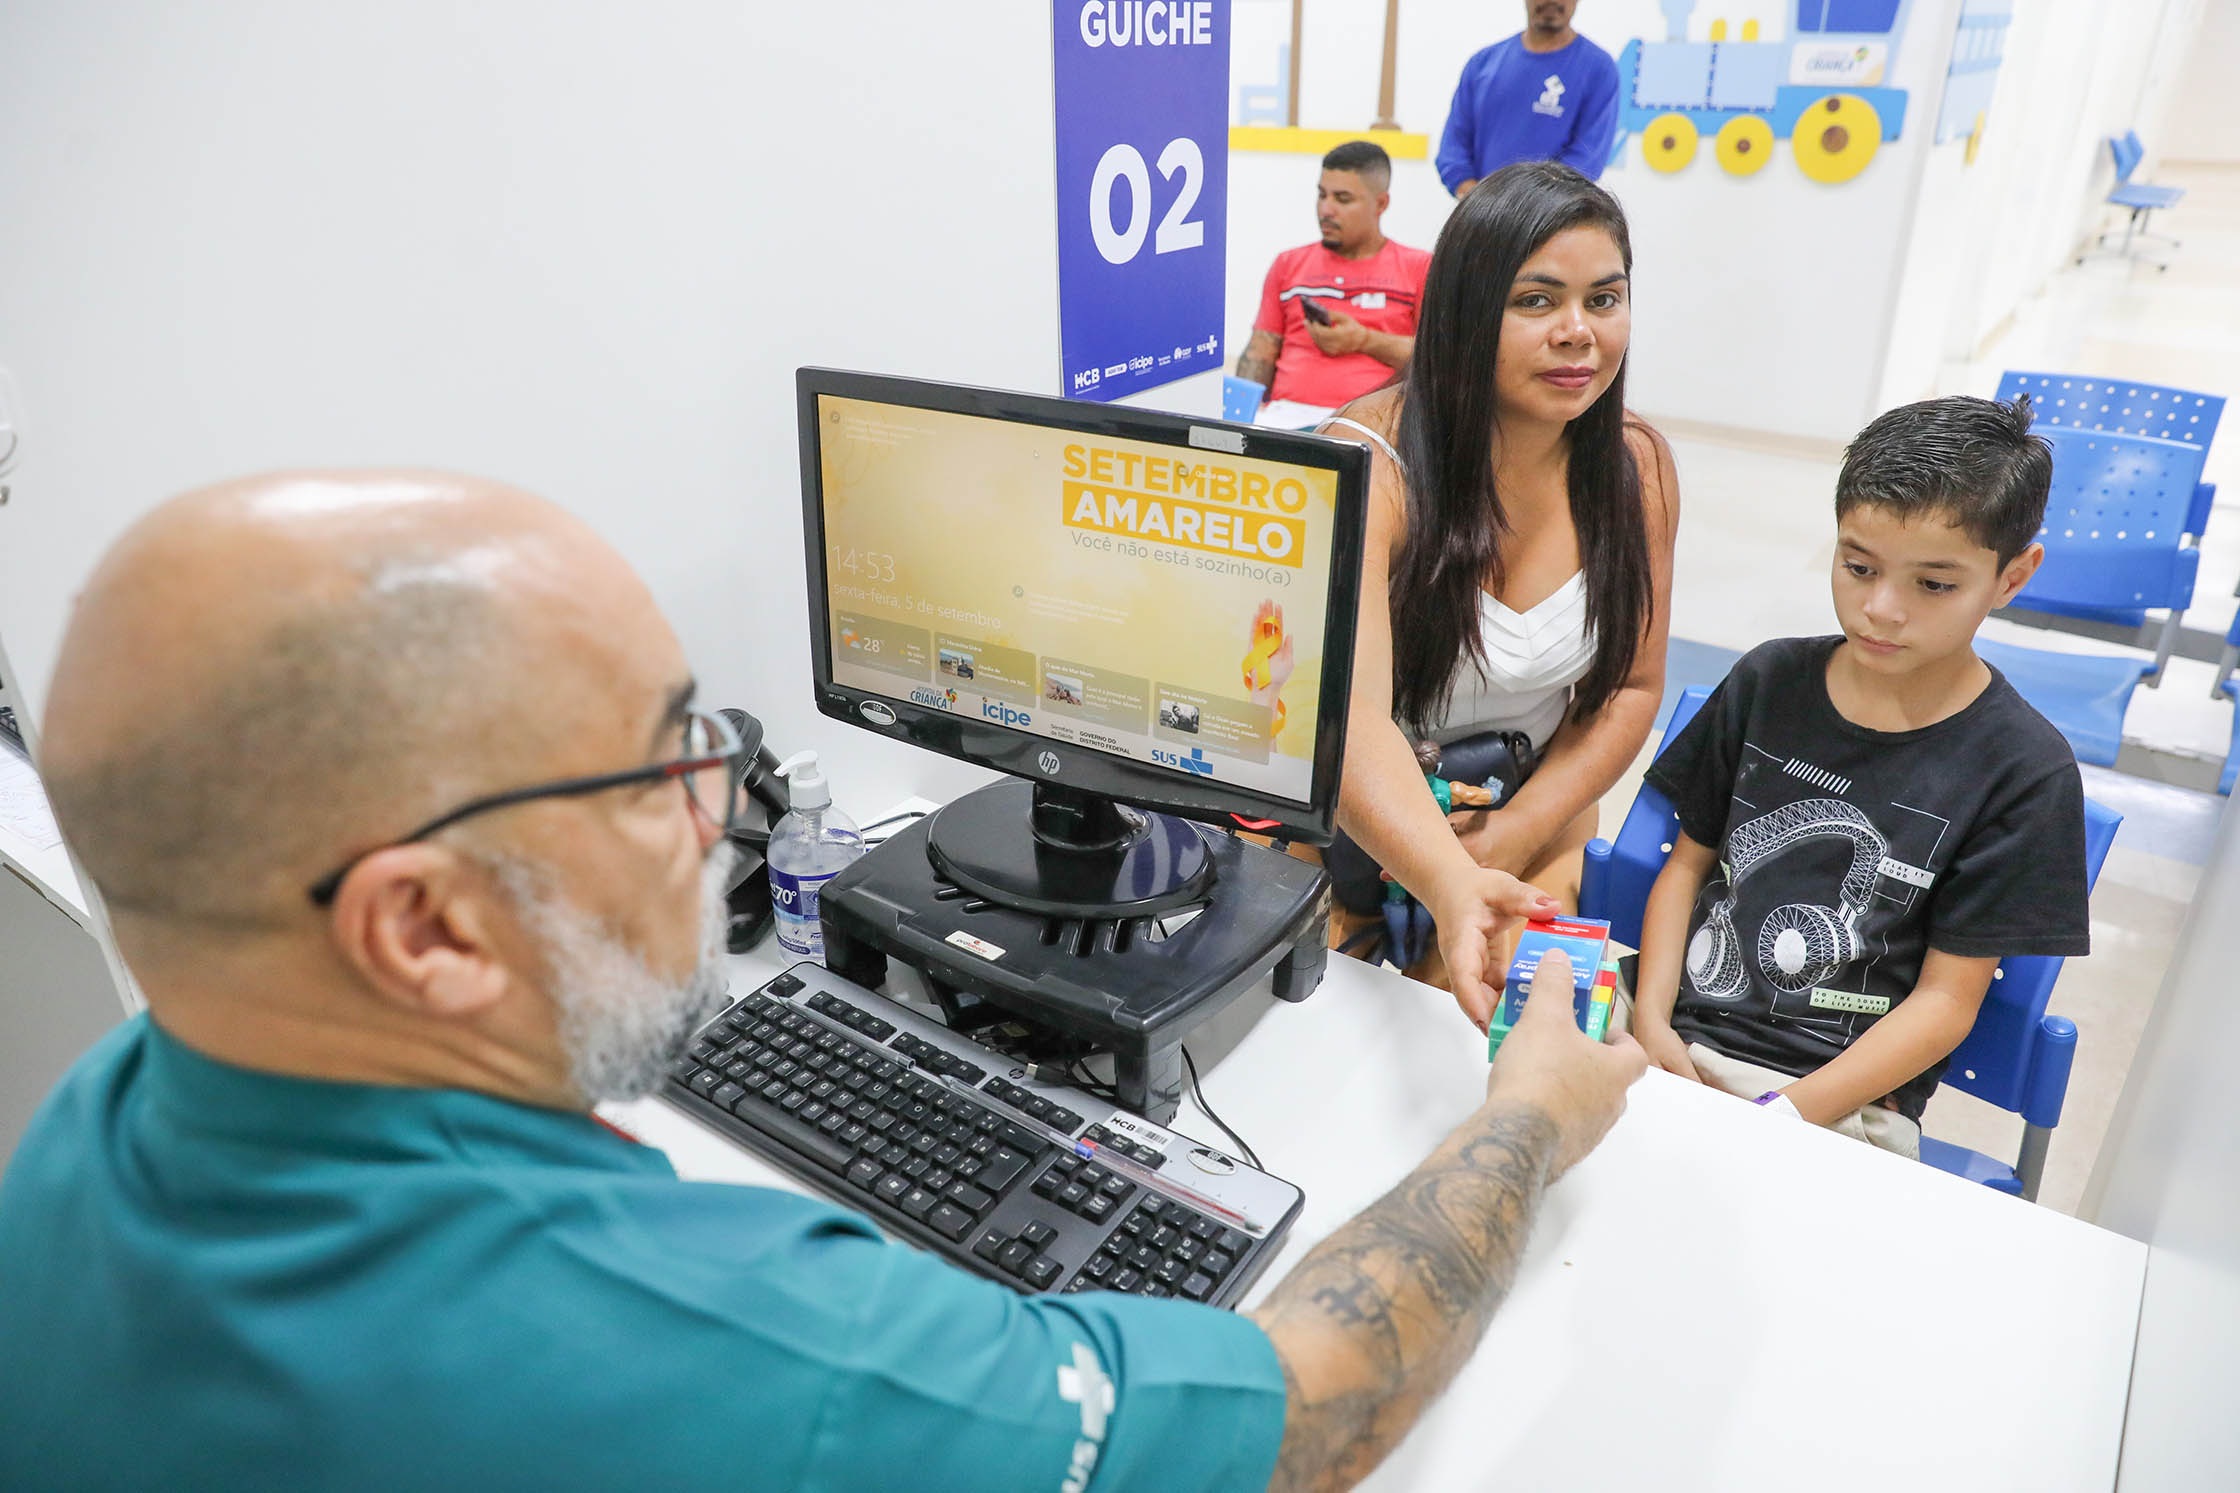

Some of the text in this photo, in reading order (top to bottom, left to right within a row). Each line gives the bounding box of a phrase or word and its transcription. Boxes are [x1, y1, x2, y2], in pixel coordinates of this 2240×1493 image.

[1090, 137, 1204, 265] 02
[1074, 367, 1100, 389] HCB
[1063, 444, 1307, 514] SETEMBRO
[1072, 490, 1293, 558] AMARELO
[832, 545, 896, 583] 14:53
[1071, 531, 1292, 587] Você não está sozinho(a)
[905, 594, 913, 609] 5
[917, 600, 934, 615] de
[937, 606, 1001, 629] setembro
[863, 637, 881, 653] 28
[982, 697, 1032, 726] icipe
[1080, 731, 1107, 742] GOVERNO
[1080, 737, 1131, 755] DISTRITO FEDERAL
[1039, 752, 1059, 774] hp
[1151, 749, 1177, 766] SUS
[1883, 866, 1907, 878] LOUD
[1885, 861, 1909, 872] PLAY
[1857, 998, 1886, 1006] SOUND
[1110, 1116, 1136, 1132] HCB
[1061, 1439, 1098, 1493] US
